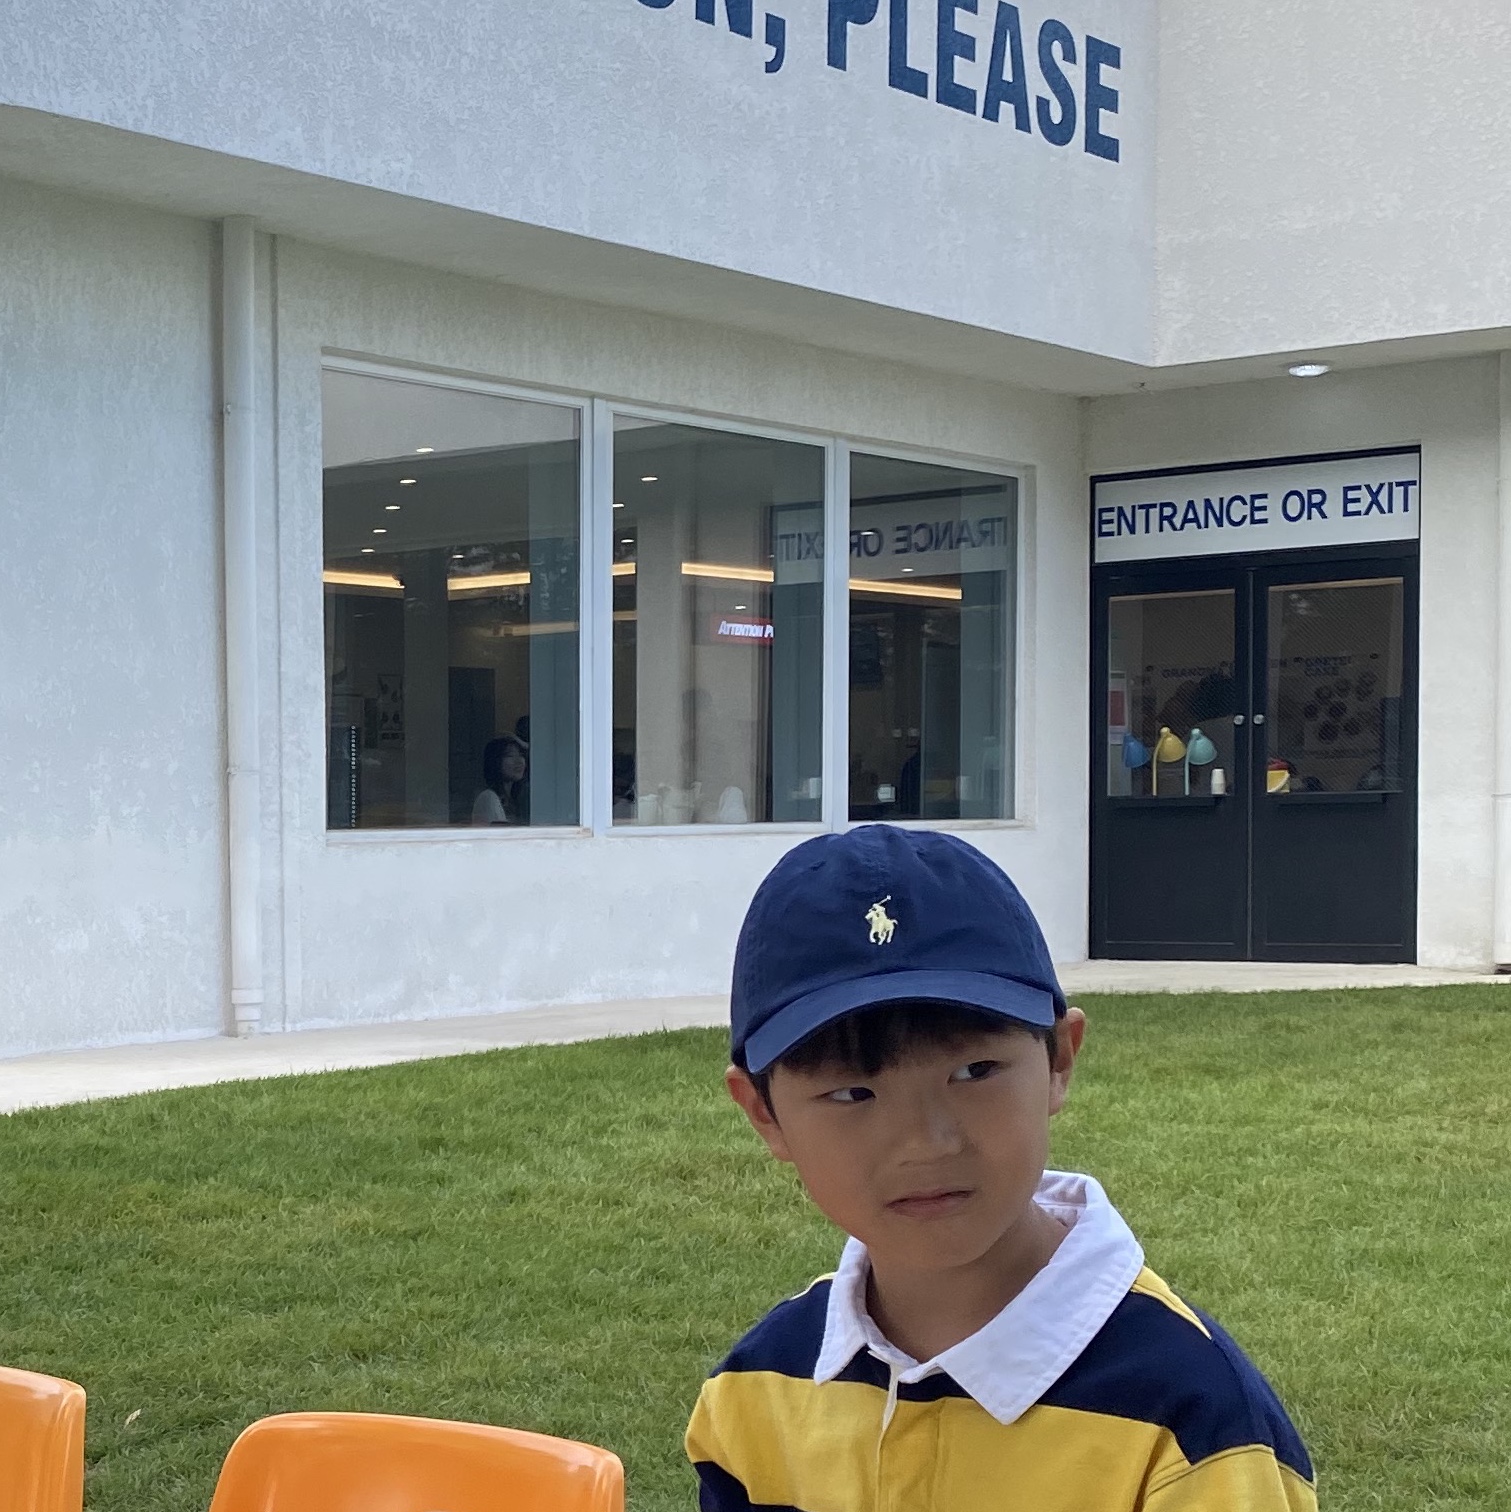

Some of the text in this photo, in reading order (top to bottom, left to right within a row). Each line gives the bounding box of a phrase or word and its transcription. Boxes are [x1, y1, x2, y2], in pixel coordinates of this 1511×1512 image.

[827, 0, 1121, 164] PLEASE
[1097, 479, 1418, 538] ENTRANCE OR EXIT
